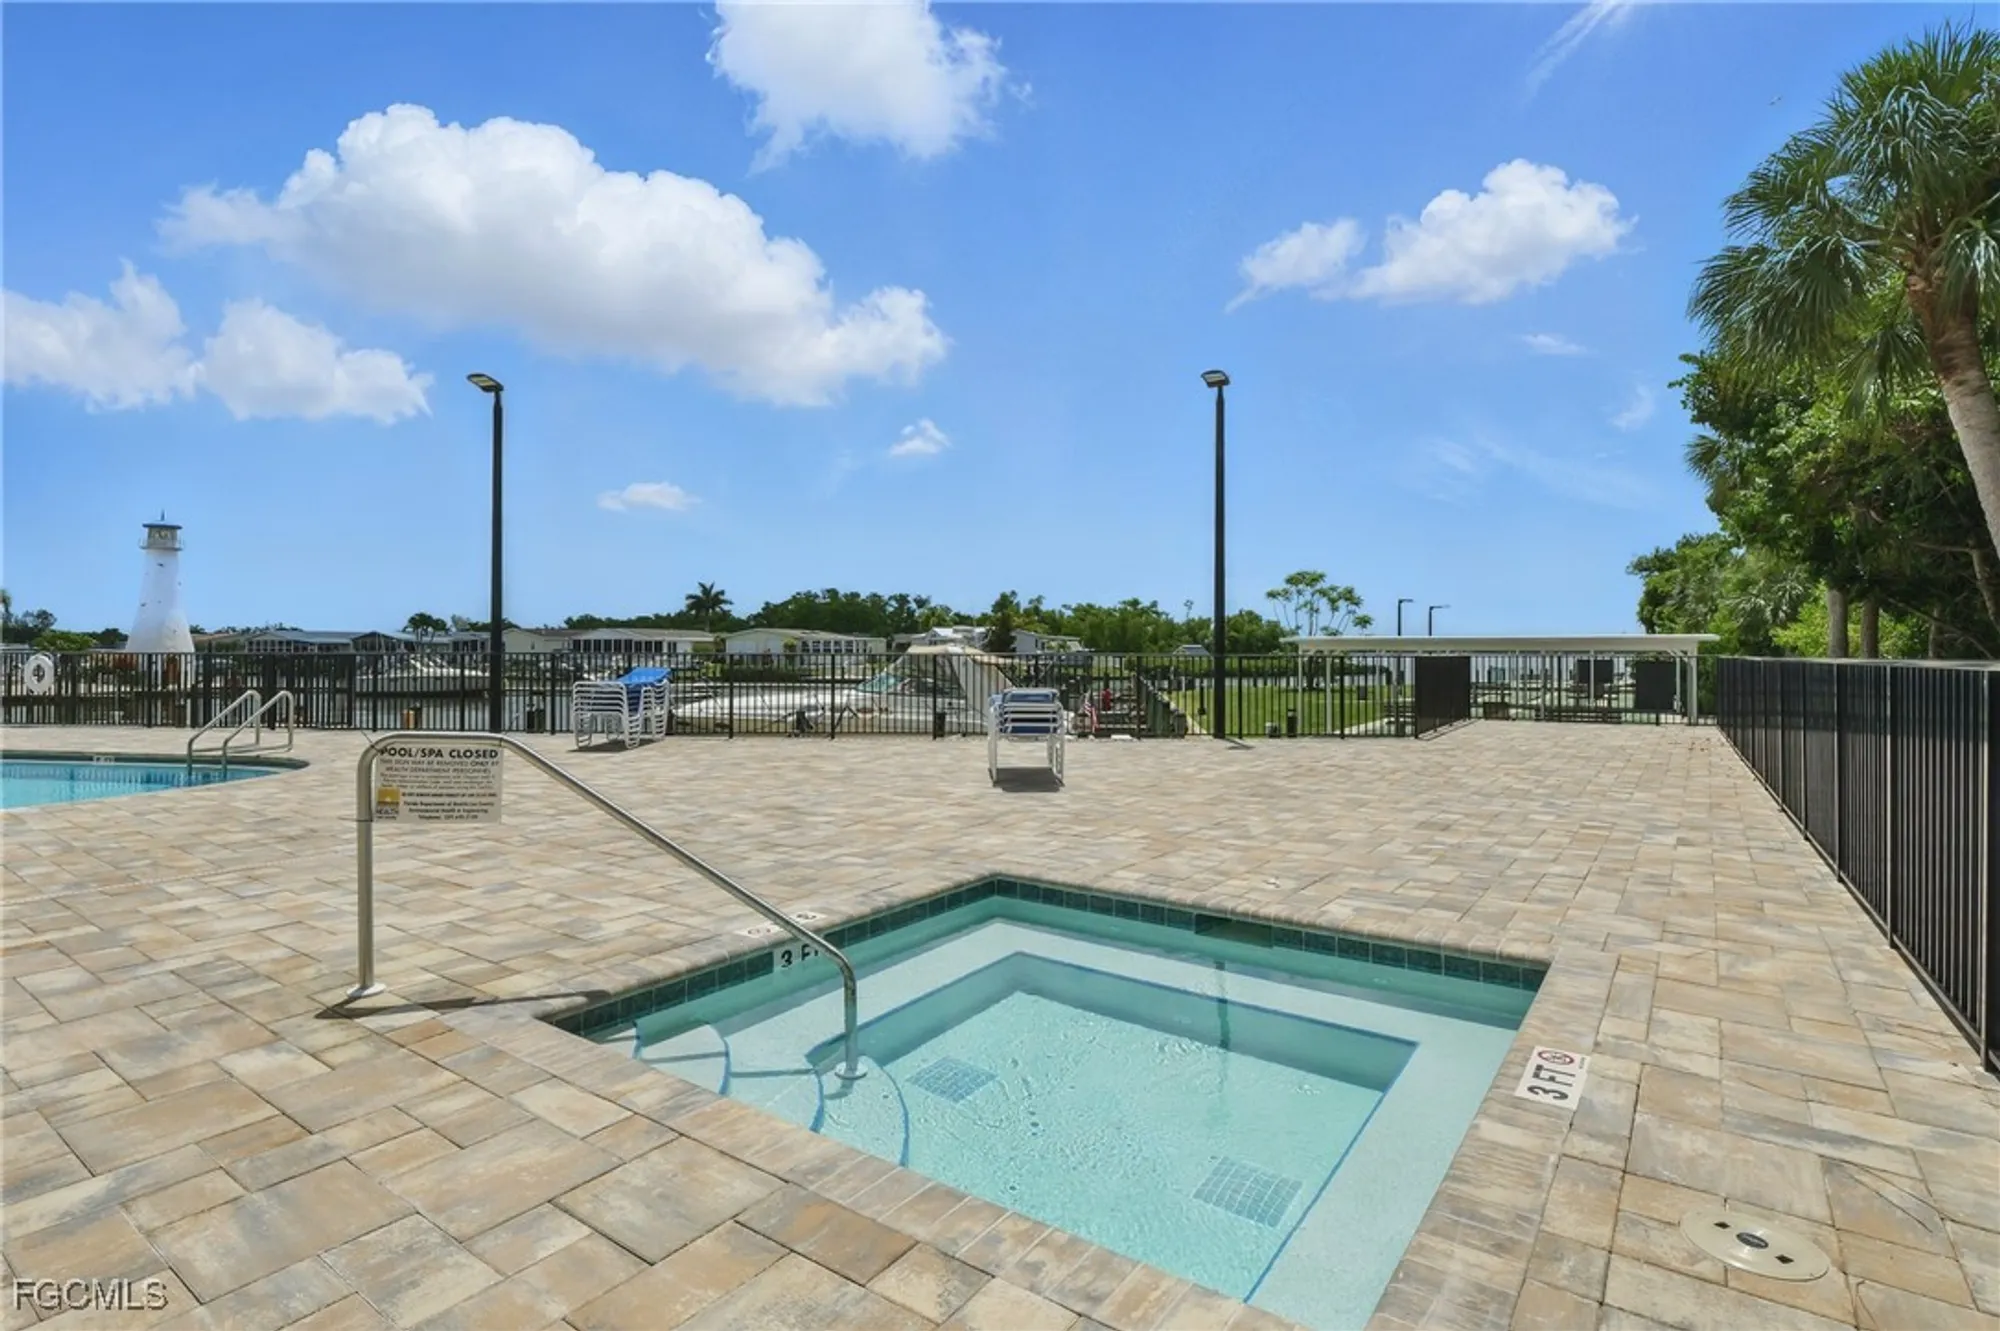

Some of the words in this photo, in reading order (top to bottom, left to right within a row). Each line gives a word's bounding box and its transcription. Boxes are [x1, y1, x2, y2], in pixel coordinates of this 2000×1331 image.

[380, 747, 444, 758] POOL/SPA
[449, 749, 498, 759] CLOSED
[781, 950, 793, 968] 3
[801, 943, 819, 961] F
[1532, 1064, 1576, 1087] FT
[1527, 1085, 1569, 1101] 3
